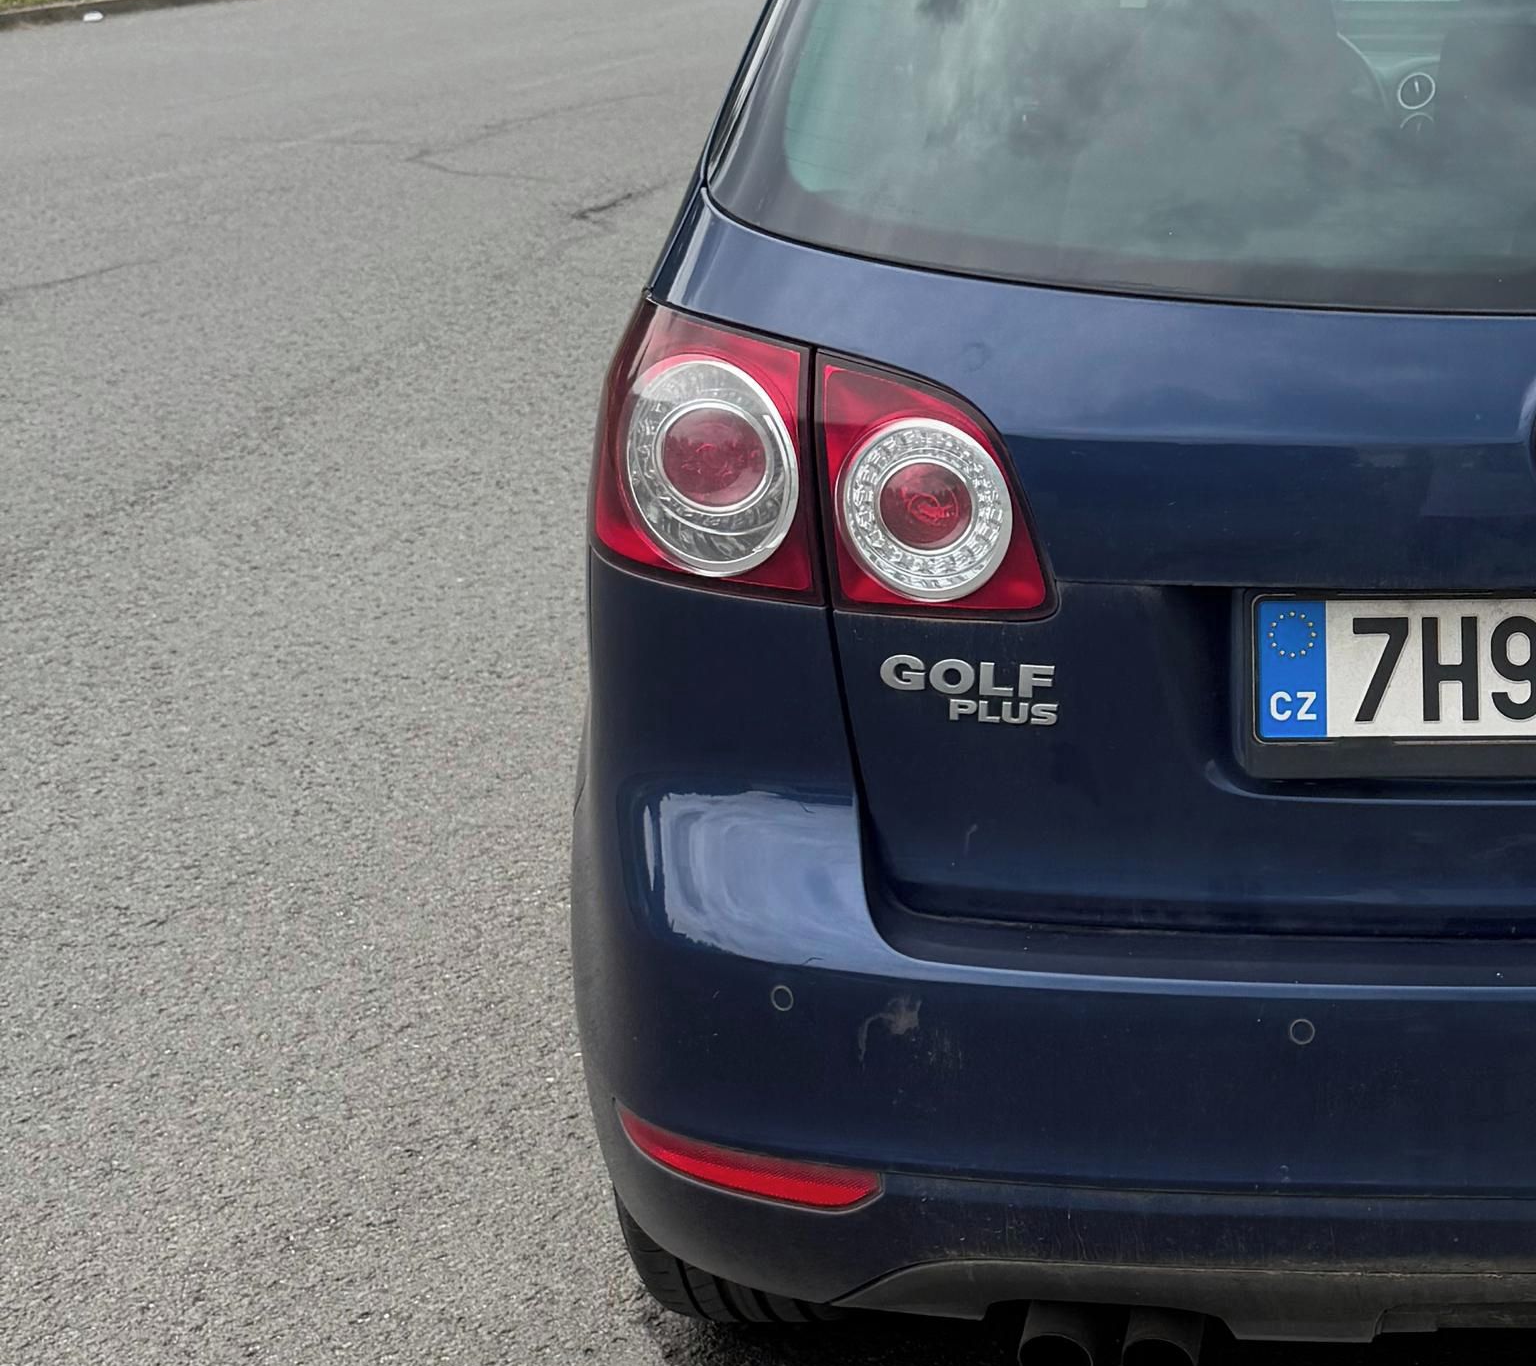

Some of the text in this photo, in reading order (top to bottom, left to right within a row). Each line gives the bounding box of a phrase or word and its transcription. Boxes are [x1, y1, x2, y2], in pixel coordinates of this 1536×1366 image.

[879, 653, 1056, 698] GOLF
[949, 698, 1059, 725] PLUS
[1269, 690, 1318, 721] CZ
